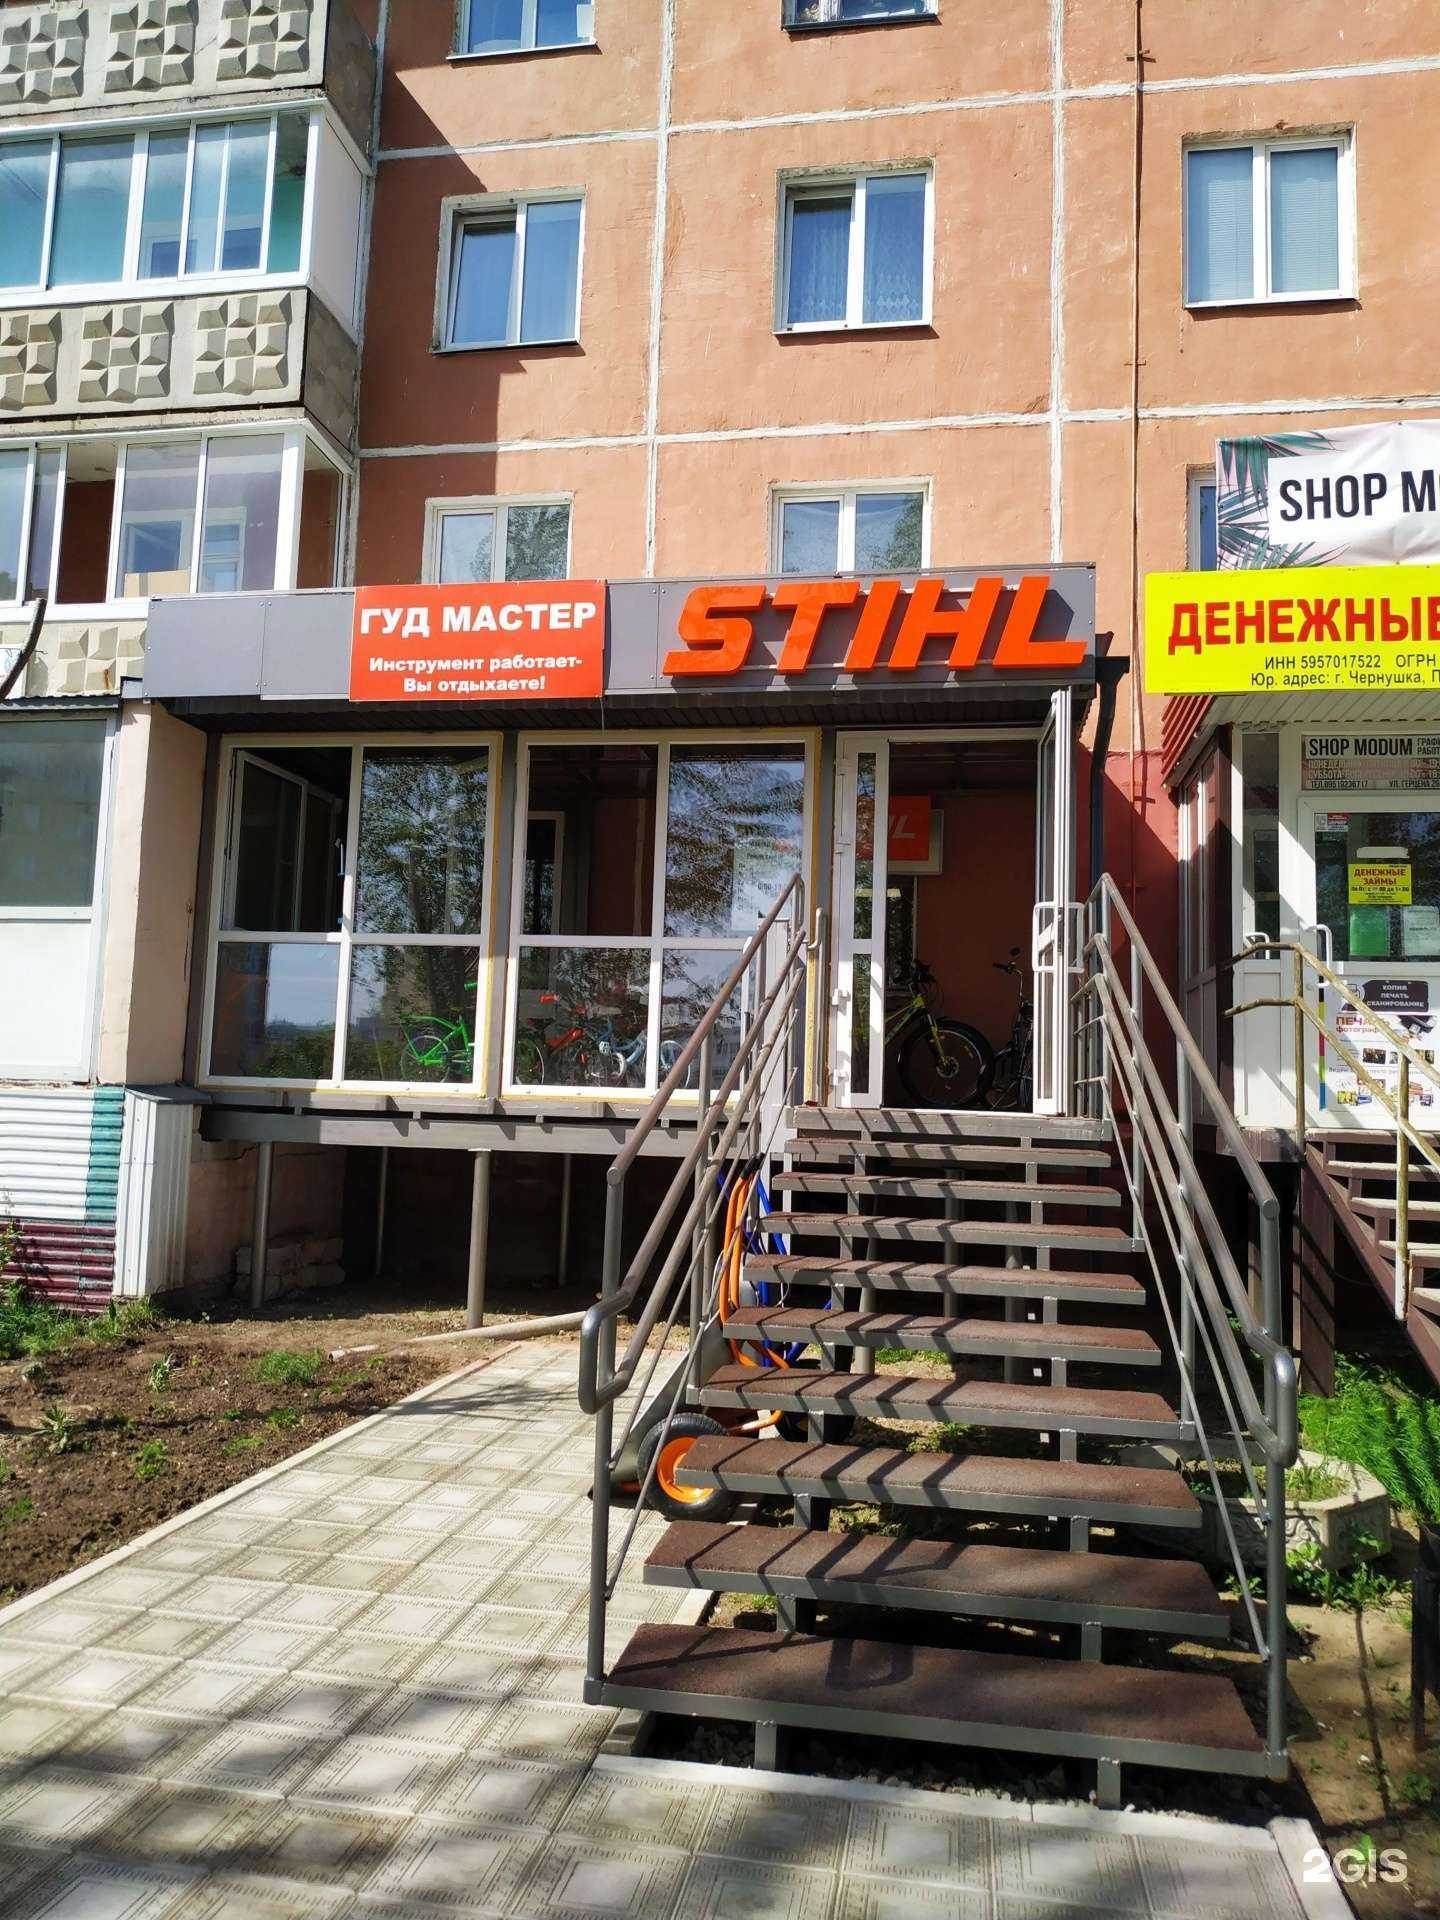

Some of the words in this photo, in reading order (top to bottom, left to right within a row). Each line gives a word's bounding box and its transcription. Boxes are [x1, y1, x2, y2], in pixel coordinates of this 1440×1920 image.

[1279, 472, 1387, 522] SHOP
[1401, 469, 1440, 513] M
[360, 607, 430, 638] ГУД
[442, 602, 596, 632] МАСТЕР
[662, 576, 1088, 676] STIHL
[369, 657, 484, 674] Инструмент
[489, 654, 583, 671] работает-
[1264, 656, 1296, 670] ИНН
[1301, 655, 1381, 669] 5957017522
[1395, 653, 1436, 668] ОГРН
[404, 678, 432, 693] Вы
[438, 676, 546, 693] отдыхаете!
[1251, 672, 1278, 687] Юр.
[1282, 672, 1330, 686] адрес:
[1335, 673, 1345, 683] г.
[1349, 669, 1426, 687] Чернушка,
[1309, 738, 1350, 756] SHOP
[1354, 738, 1413, 756] MODUM
[1354, 868, 1406, 878] ДЕНЕЖНЫЕ
[1363, 876, 1397, 885] ЗАЙМЫ
